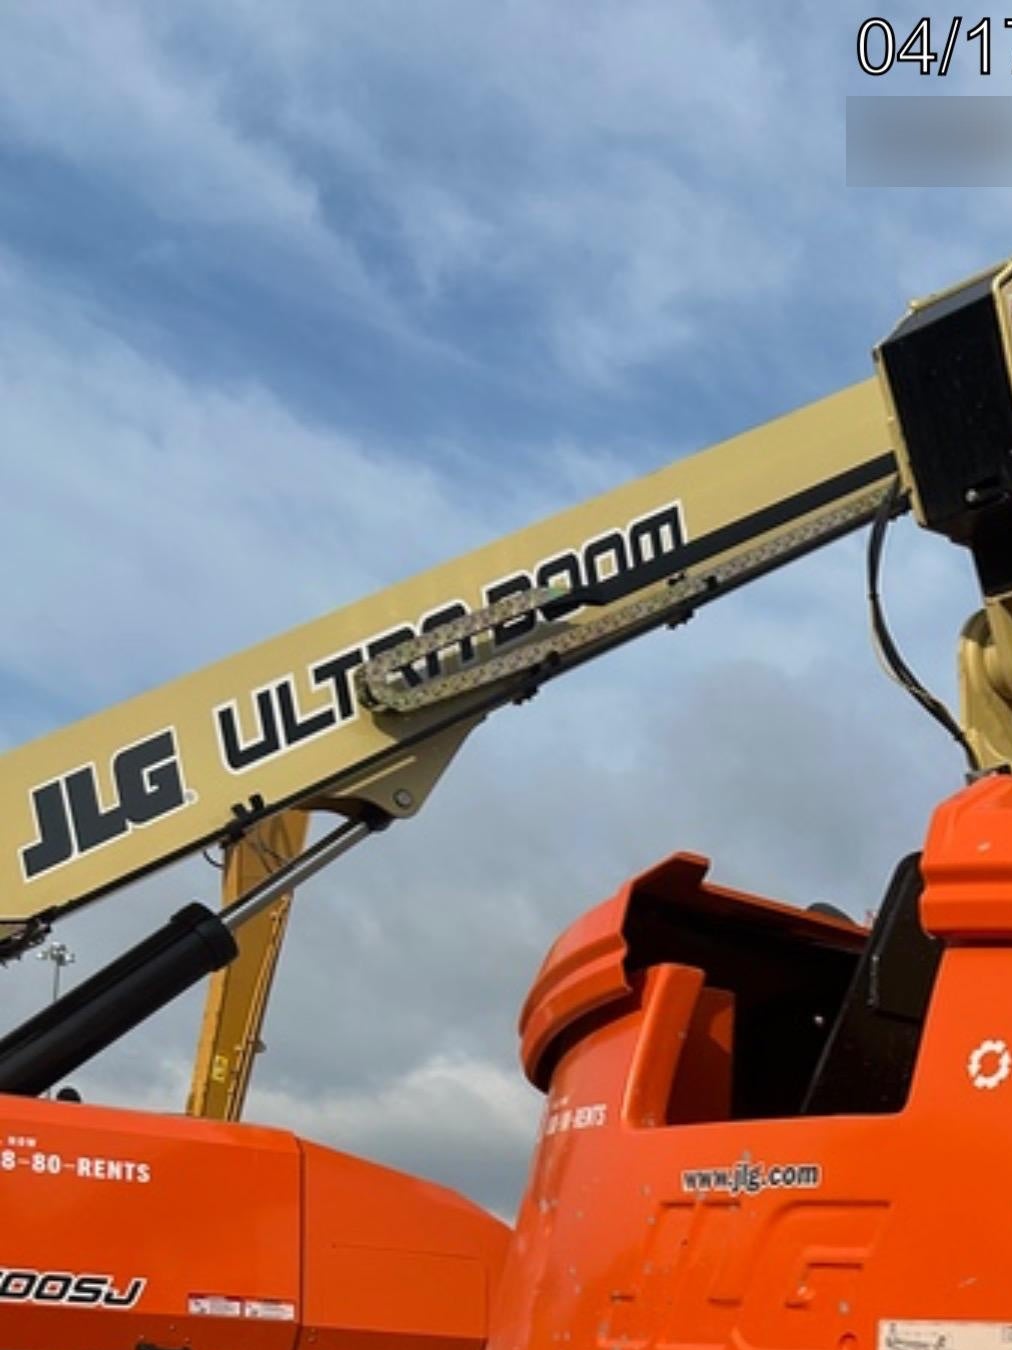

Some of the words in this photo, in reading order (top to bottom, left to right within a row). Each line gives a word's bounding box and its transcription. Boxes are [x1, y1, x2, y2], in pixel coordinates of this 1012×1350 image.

[18, 726, 188, 882] JLG
[682, 1162, 820, 1193] www.jlg.com
[0, 1268, 147, 1311] 00SJ
